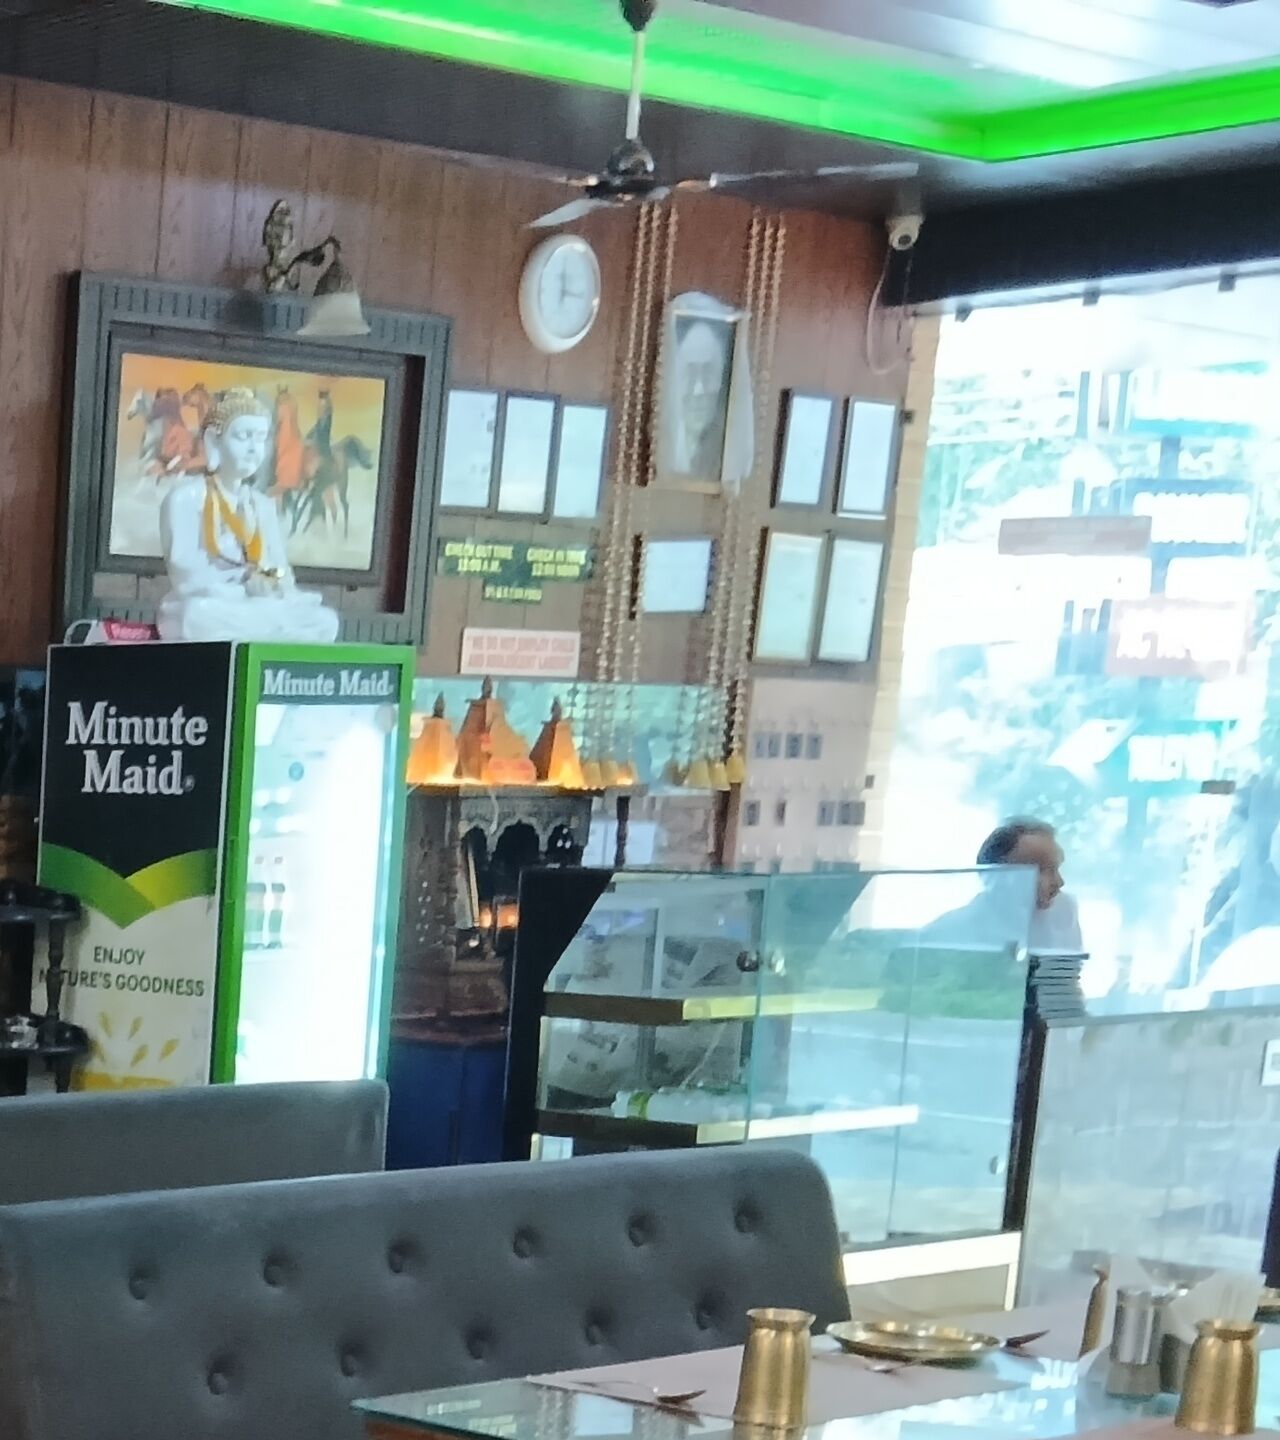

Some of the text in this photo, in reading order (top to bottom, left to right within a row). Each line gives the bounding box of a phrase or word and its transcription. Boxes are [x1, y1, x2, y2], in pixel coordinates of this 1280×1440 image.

[264, 669, 390, 696] Minute Maid
[65, 701, 208, 746] Minute
[81, 750, 185, 795] Maid
[93, 946, 145, 965] ENJOY
[39, 968, 205, 997] TURE'S GOODNESS
